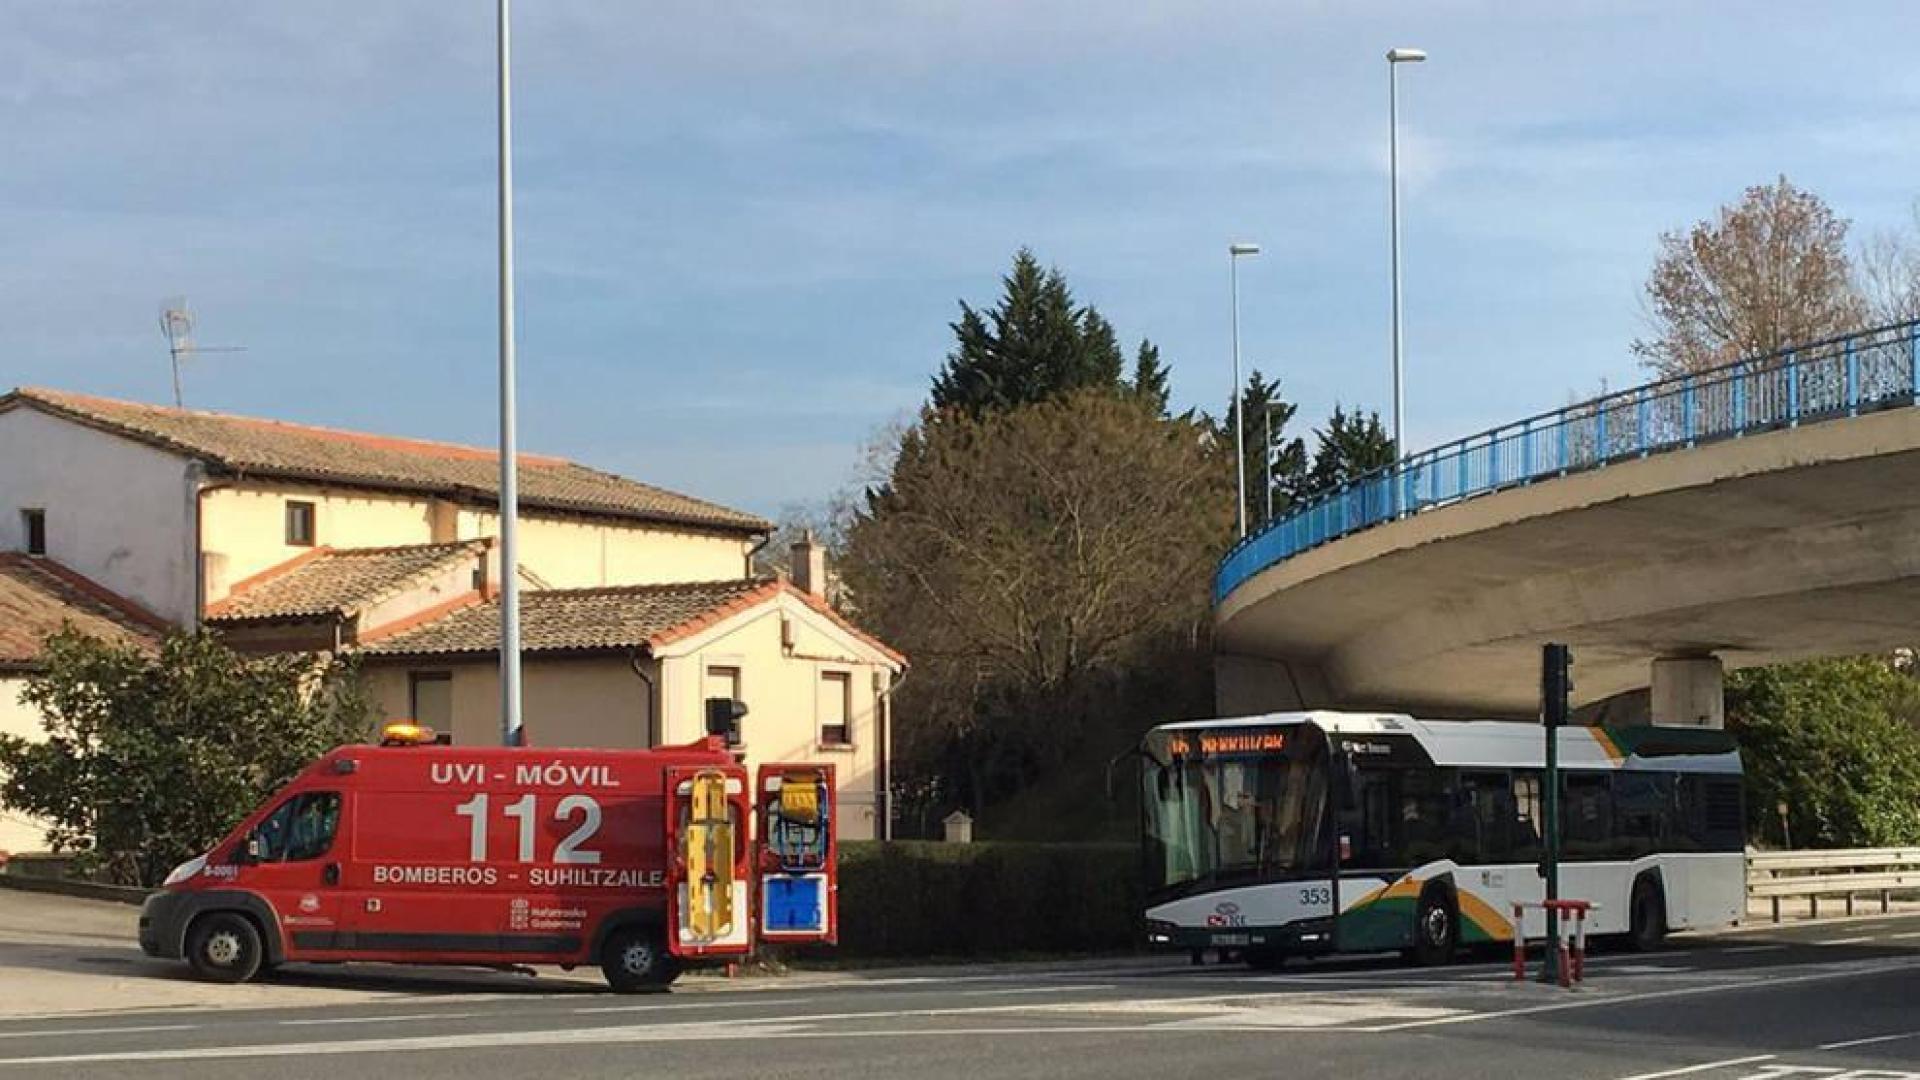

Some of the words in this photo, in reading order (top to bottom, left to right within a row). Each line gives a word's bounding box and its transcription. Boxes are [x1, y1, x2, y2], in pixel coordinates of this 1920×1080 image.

[431, 763, 485, 784] UVI
[515, 760, 620, 786] MÓVIL
[456, 793, 601, 864] 112
[373, 866, 498, 885] BOMBEROS
[529, 868, 668, 887] SUHILTZAILE
[1300, 888, 1330, 905] 353
